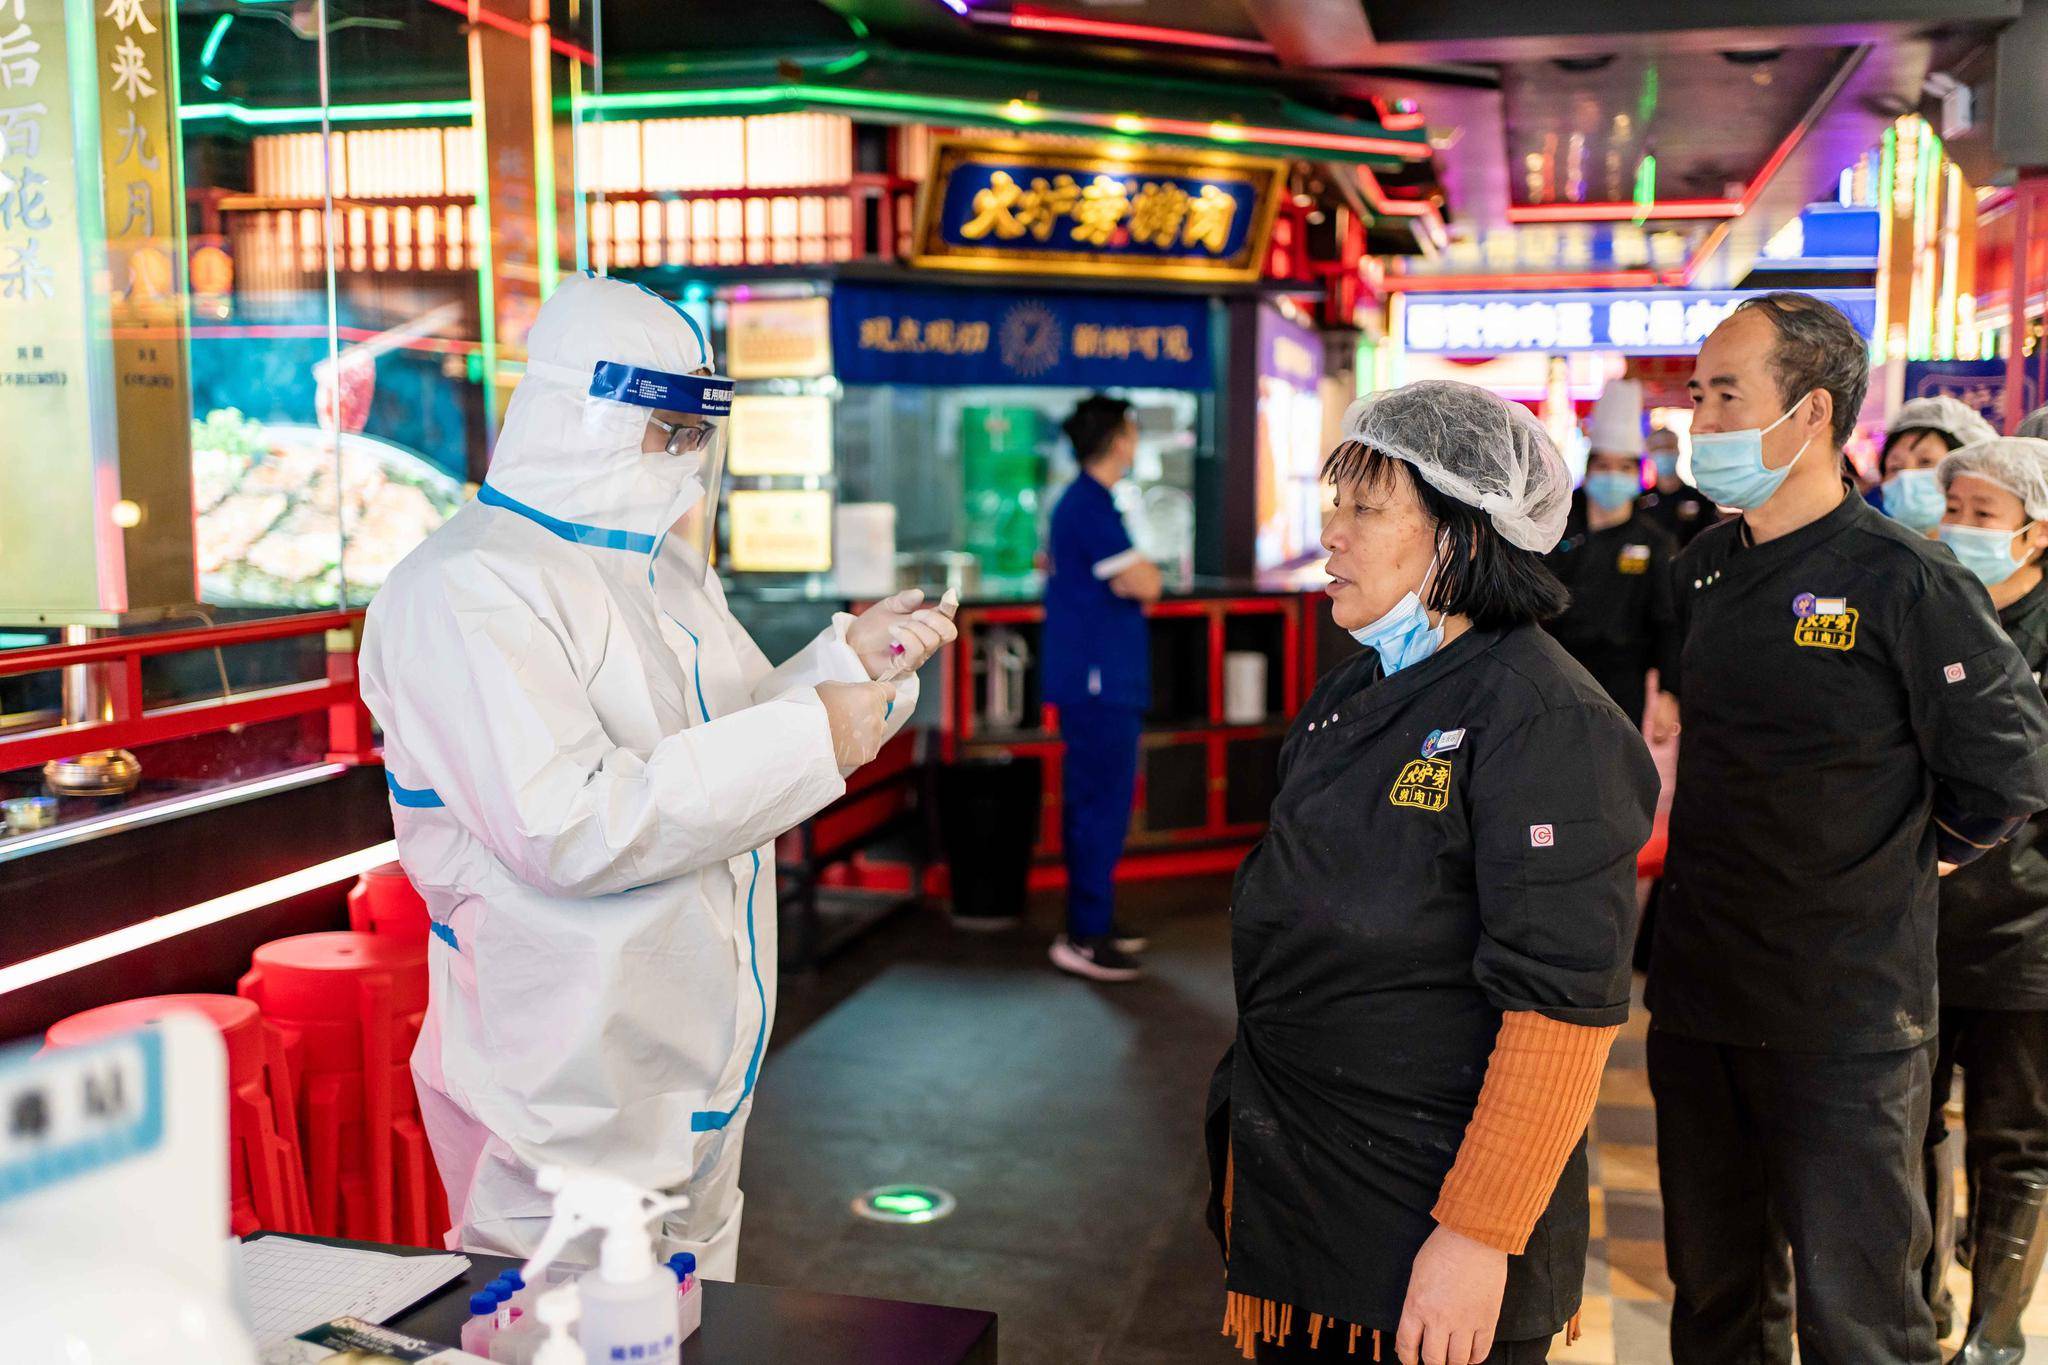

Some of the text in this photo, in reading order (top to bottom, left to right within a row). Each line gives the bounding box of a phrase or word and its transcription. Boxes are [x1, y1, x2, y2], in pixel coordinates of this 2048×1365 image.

[0, 0, 53, 300] 后百花杀
[1403, 764, 1447, 788] 火炉旁
